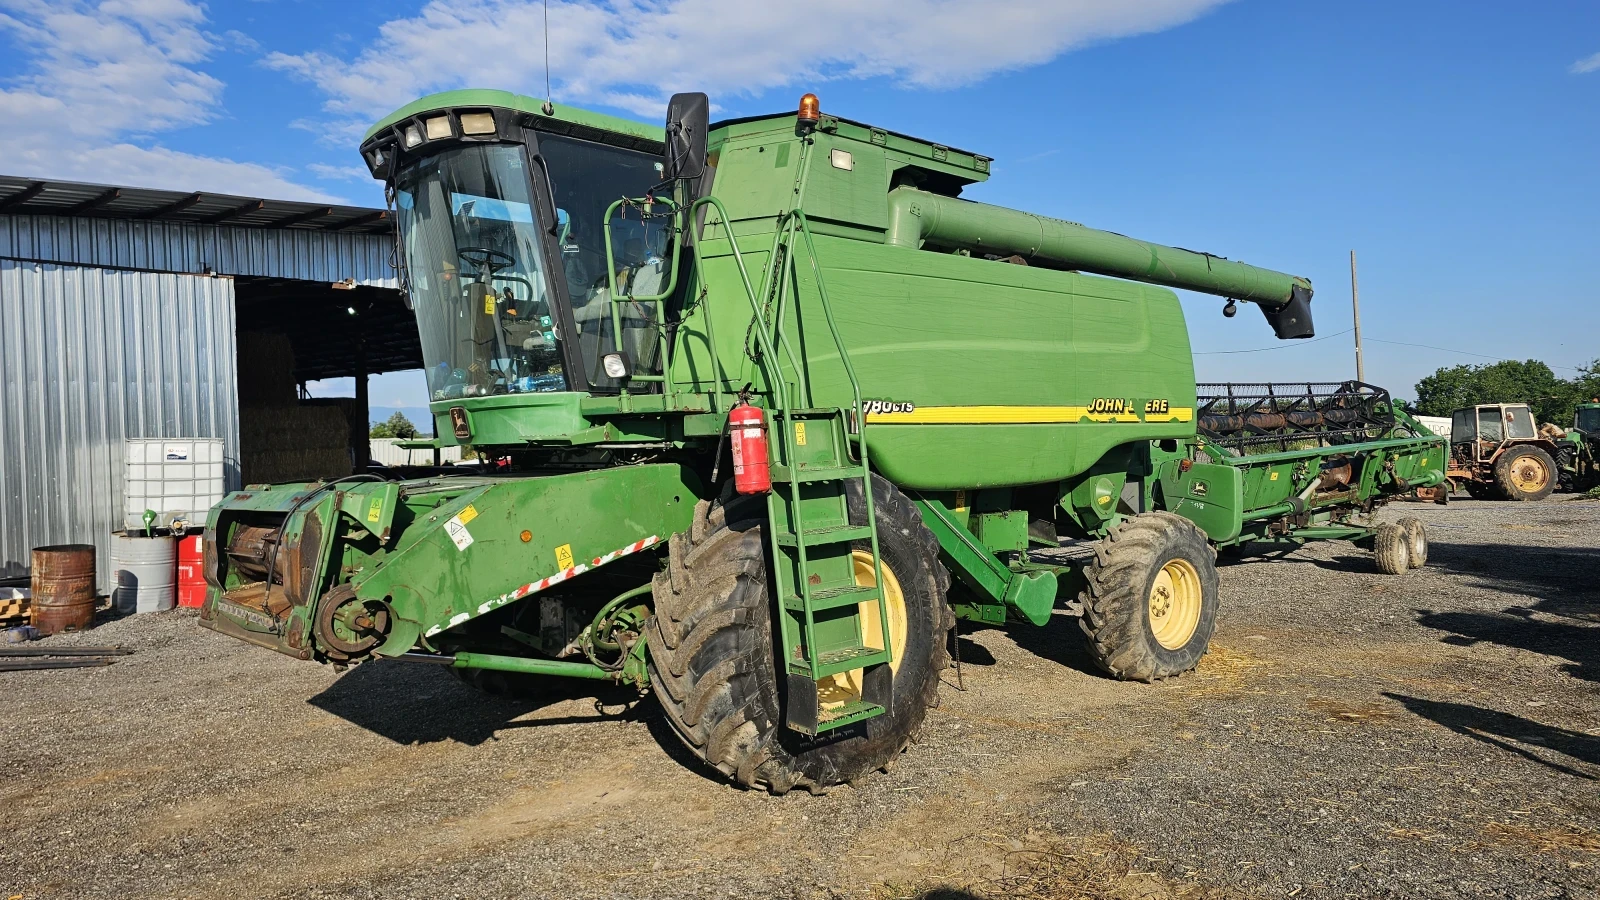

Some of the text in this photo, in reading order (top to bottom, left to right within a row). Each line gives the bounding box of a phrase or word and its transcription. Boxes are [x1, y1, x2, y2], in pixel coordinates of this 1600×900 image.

[853, 400, 915, 414] 780CTS
[1087, 398, 1169, 413] JOHN ERE
